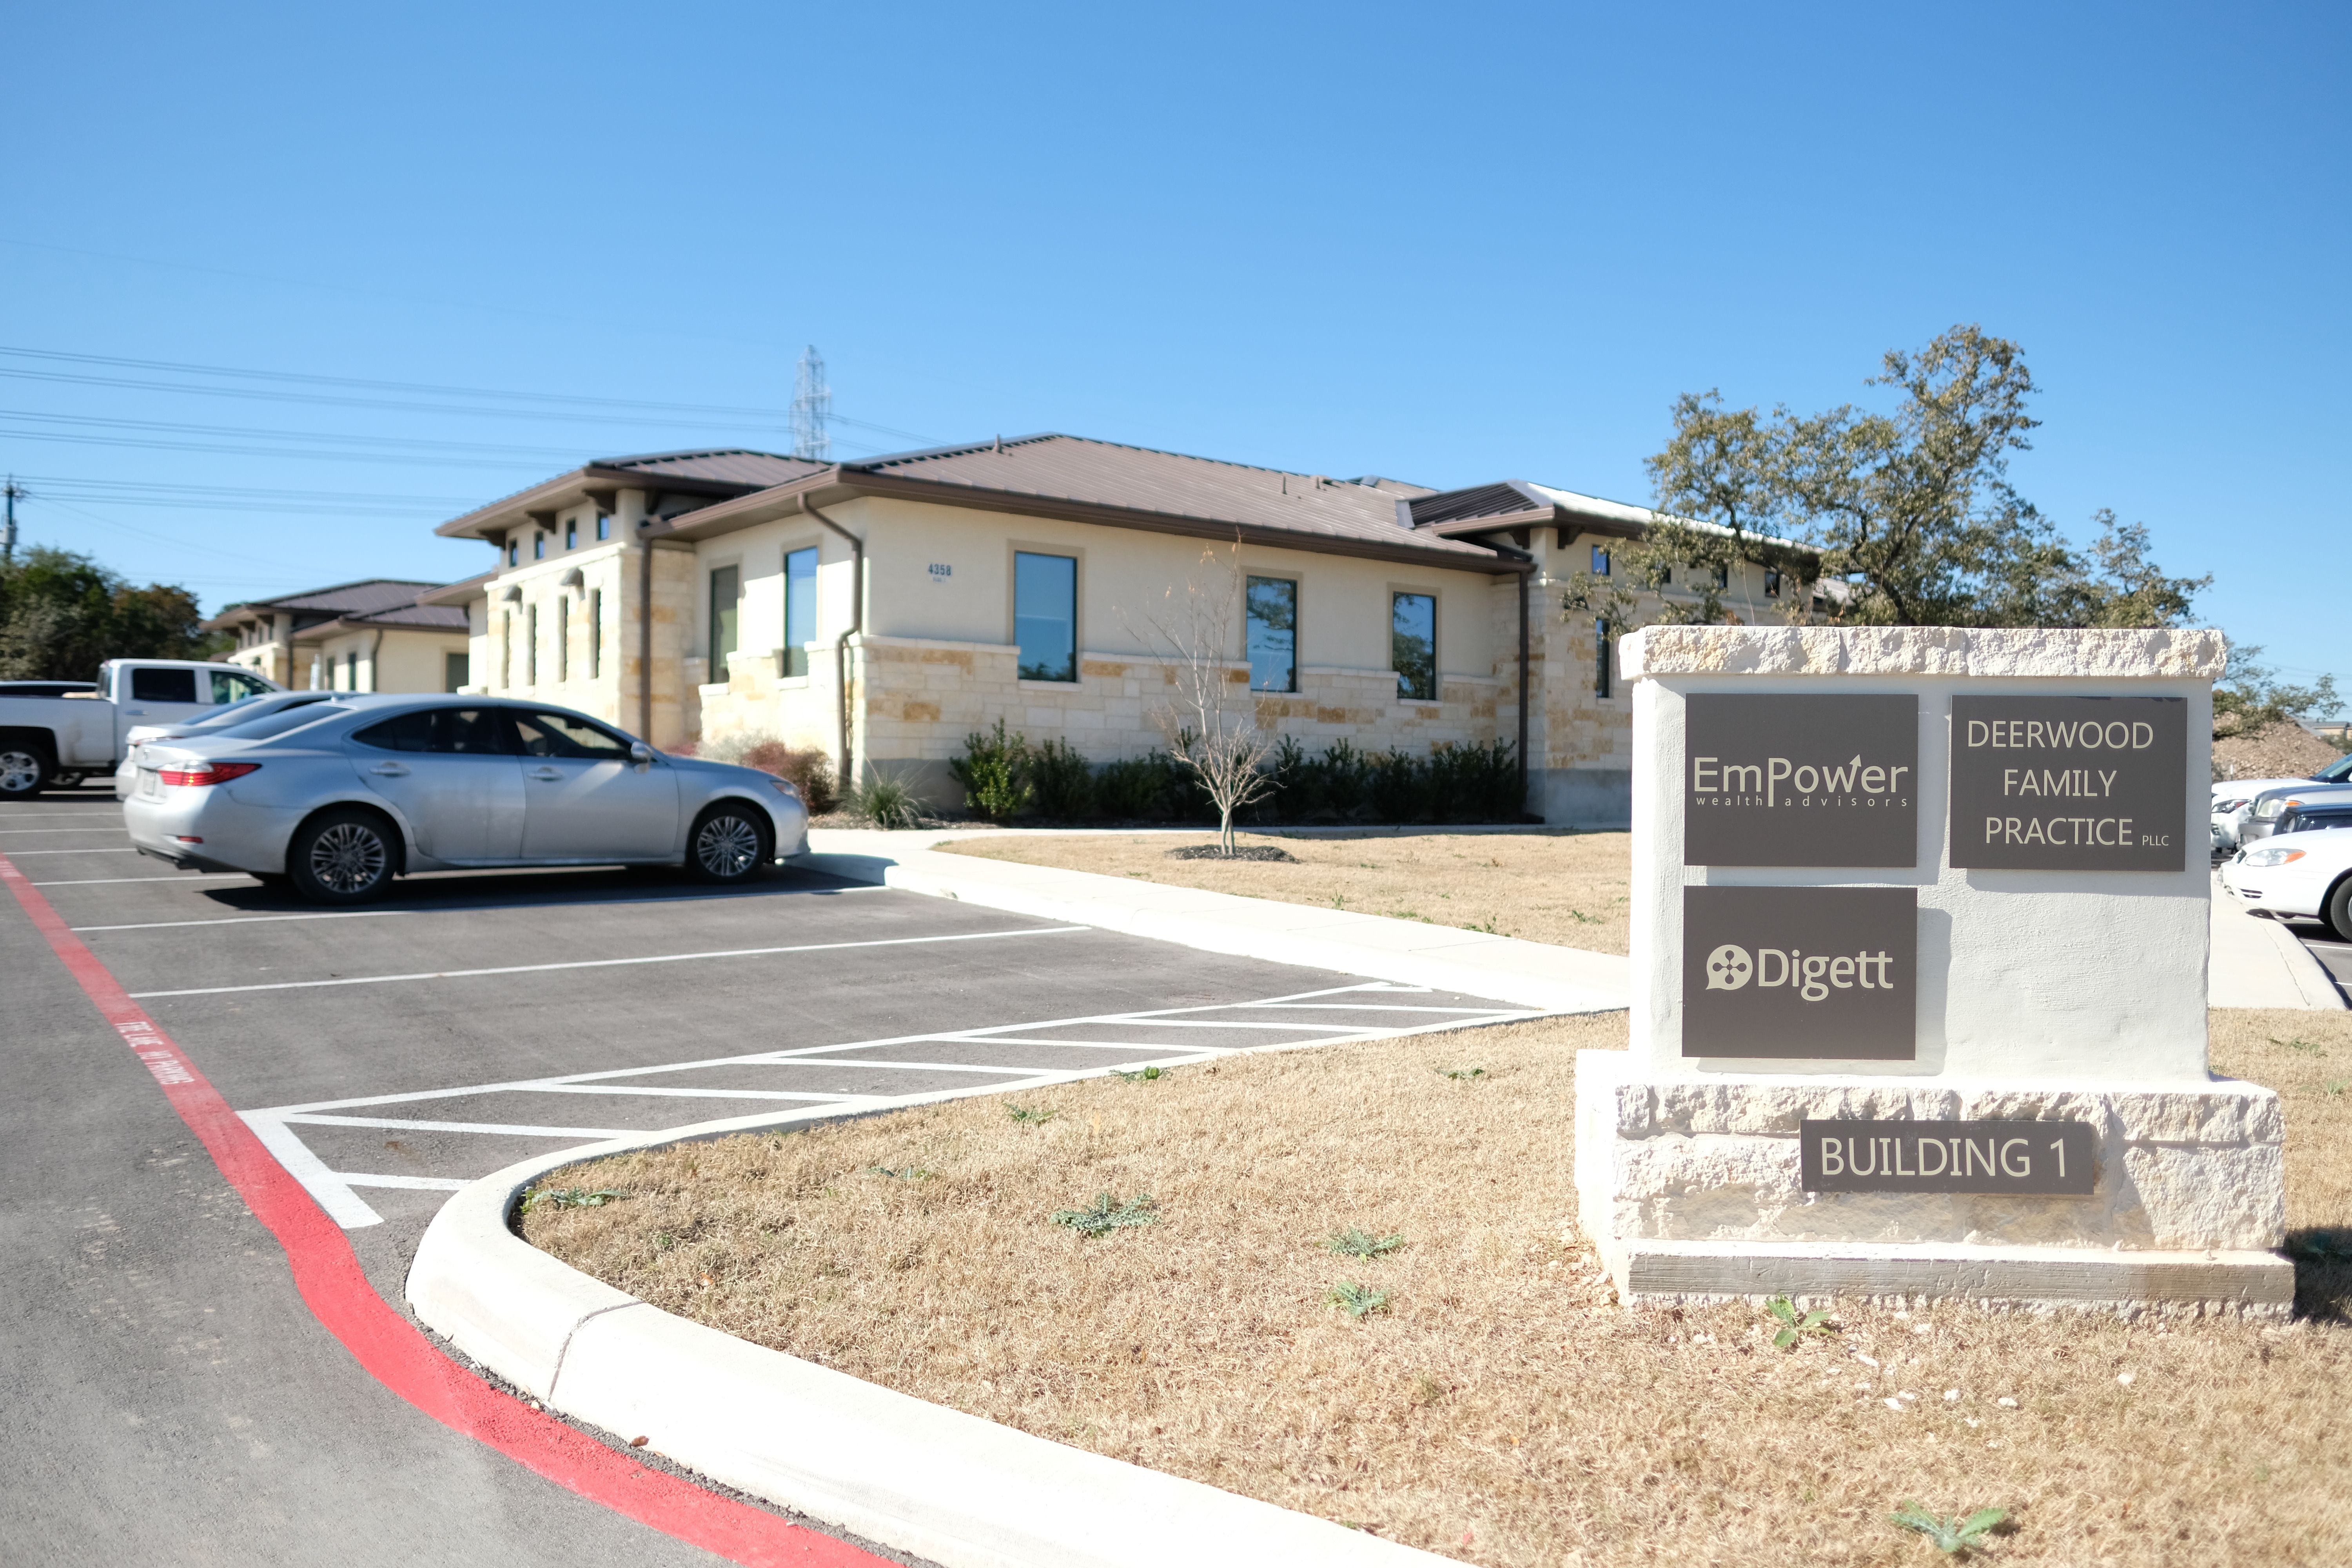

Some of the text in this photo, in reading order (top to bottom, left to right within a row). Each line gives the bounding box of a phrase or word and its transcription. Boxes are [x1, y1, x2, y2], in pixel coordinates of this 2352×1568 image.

[928, 563, 951, 576] 4358
[1968, 720, 2153, 749] DEERWOOD
[1694, 753, 1909, 807] EmPower
[2004, 769, 2117, 797] FAMILY
[1696, 795, 1907, 807] wealth advisors
[1986, 817, 2169, 846] PRACTICE PLLC
[1758, 948, 1894, 1002] Digett
[137, 1050, 173, 1060] NO
[144, 1060, 195, 1085] PARKING
[1821, 1137, 2065, 1178] BUILDING 1
